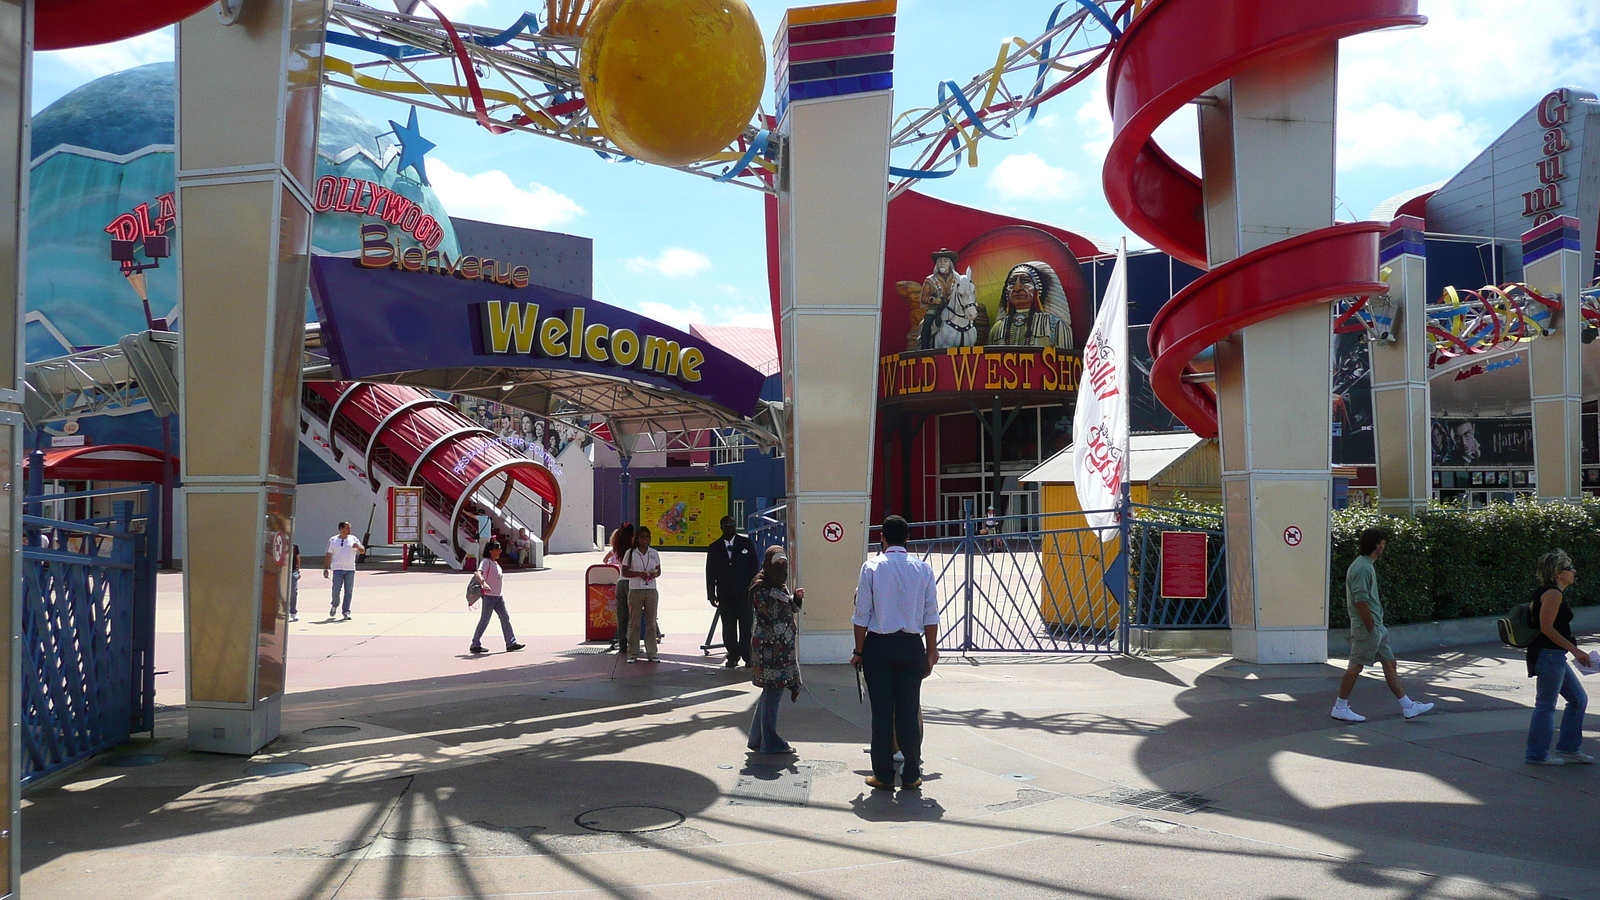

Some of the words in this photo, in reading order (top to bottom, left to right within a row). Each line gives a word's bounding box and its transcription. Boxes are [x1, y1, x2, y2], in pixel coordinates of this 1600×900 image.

[1521, 88, 1568, 228] Gaum
[104, 191, 176, 277] PLA
[314, 174, 445, 250] OLLYWOOD
[360, 223, 530, 288] Bienvenue
[486, 300, 705, 382] Welcome
[880, 353, 937, 398] WILD
[946, 345, 1035, 391] WEST
[1042, 346, 1085, 391] SHO
[507, 436, 526, 446] BAR
[528, 441, 563, 478] BOUTIQUE
